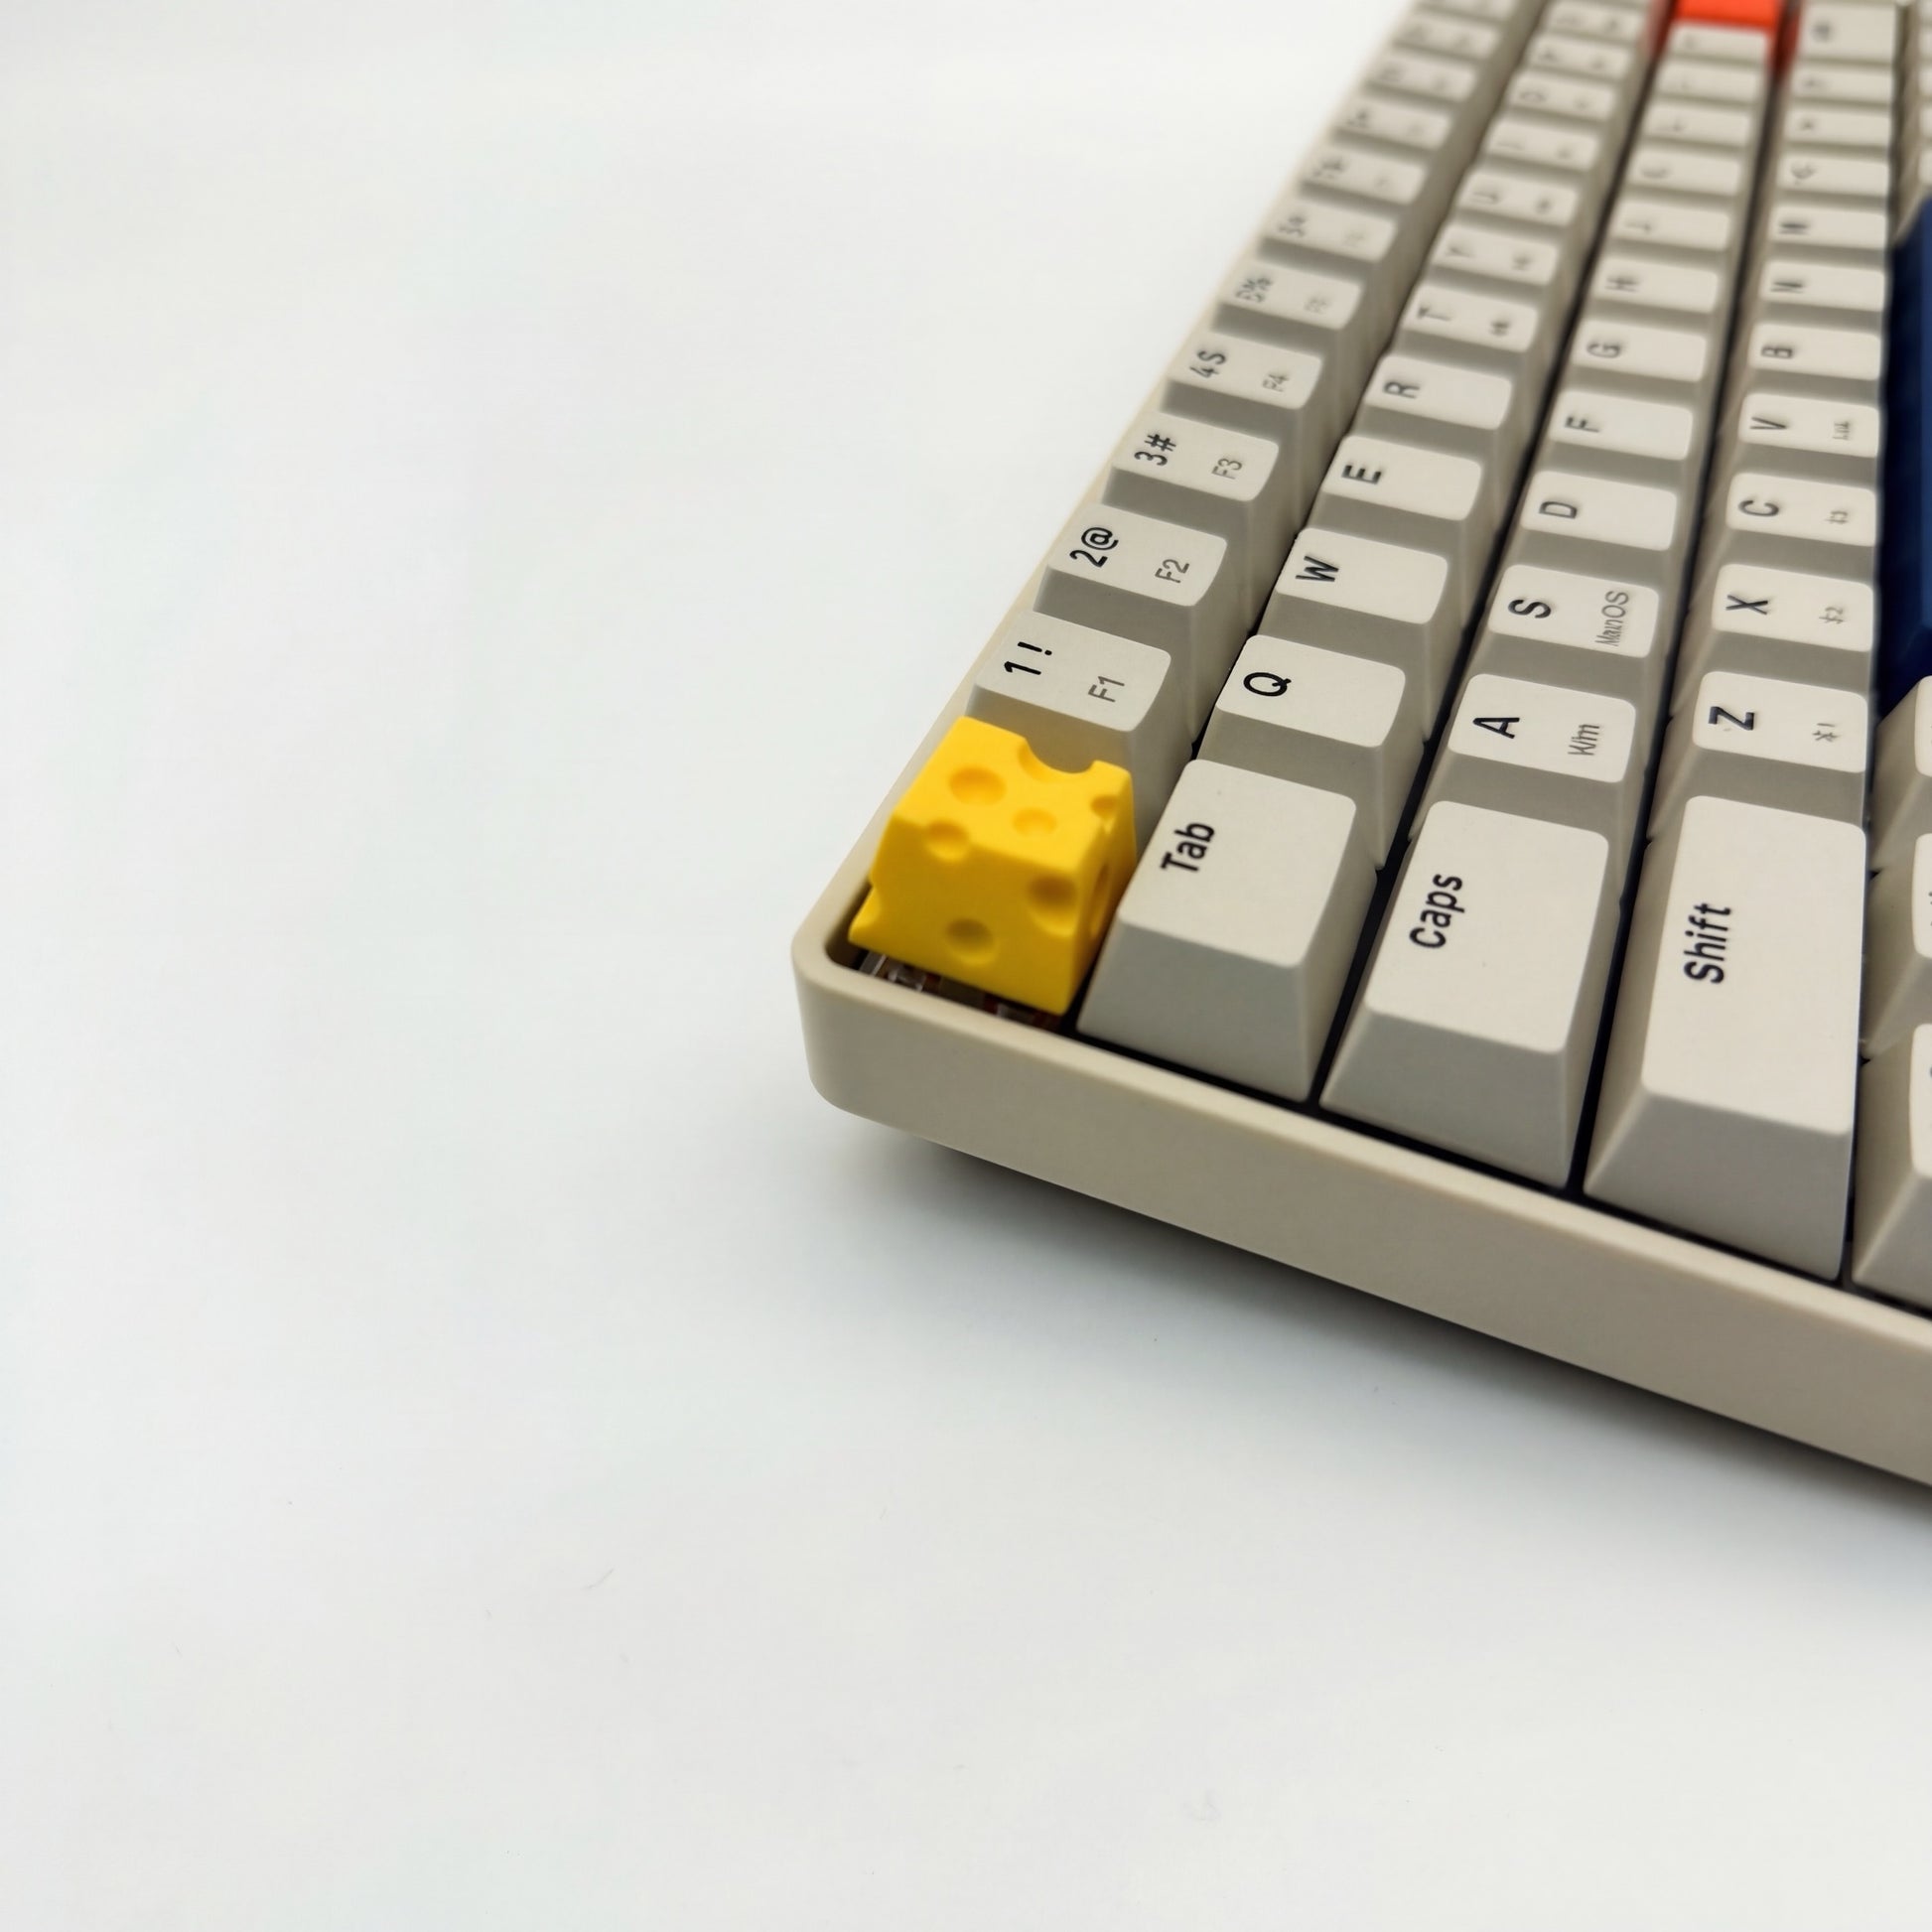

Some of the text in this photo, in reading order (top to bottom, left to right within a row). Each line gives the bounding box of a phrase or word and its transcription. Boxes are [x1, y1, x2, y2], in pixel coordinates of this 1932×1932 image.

[1587, 342, 1623, 358] G
[1761, 345, 1795, 358] B
[1383, 379, 1420, 398] R
[1565, 416, 1598, 432] F
[1750, 417, 1788, 430] V
[1134, 434, 1176, 466] 3#
[1212, 458, 1242, 480] F3
[1342, 465, 1382, 484] E
[1539, 500, 1579, 519] D
[1738, 499, 1780, 516] C
[1069, 527, 1119, 567] 2@
[1155, 559, 1189, 583] F2
[1296, 556, 1339, 582] W
[1508, 600, 1552, 619] S
[1726, 595, 1768, 615] X
[1088, 676, 1125, 702] F1
[1243, 672, 1292, 697] Q
[1473, 717, 1520, 739] A
[1709, 706, 1755, 731] Z
[1161, 821, 1215, 873] Tab
[1409, 874, 1465, 949] Caps
[1684, 903, 1731, 984] Shift
